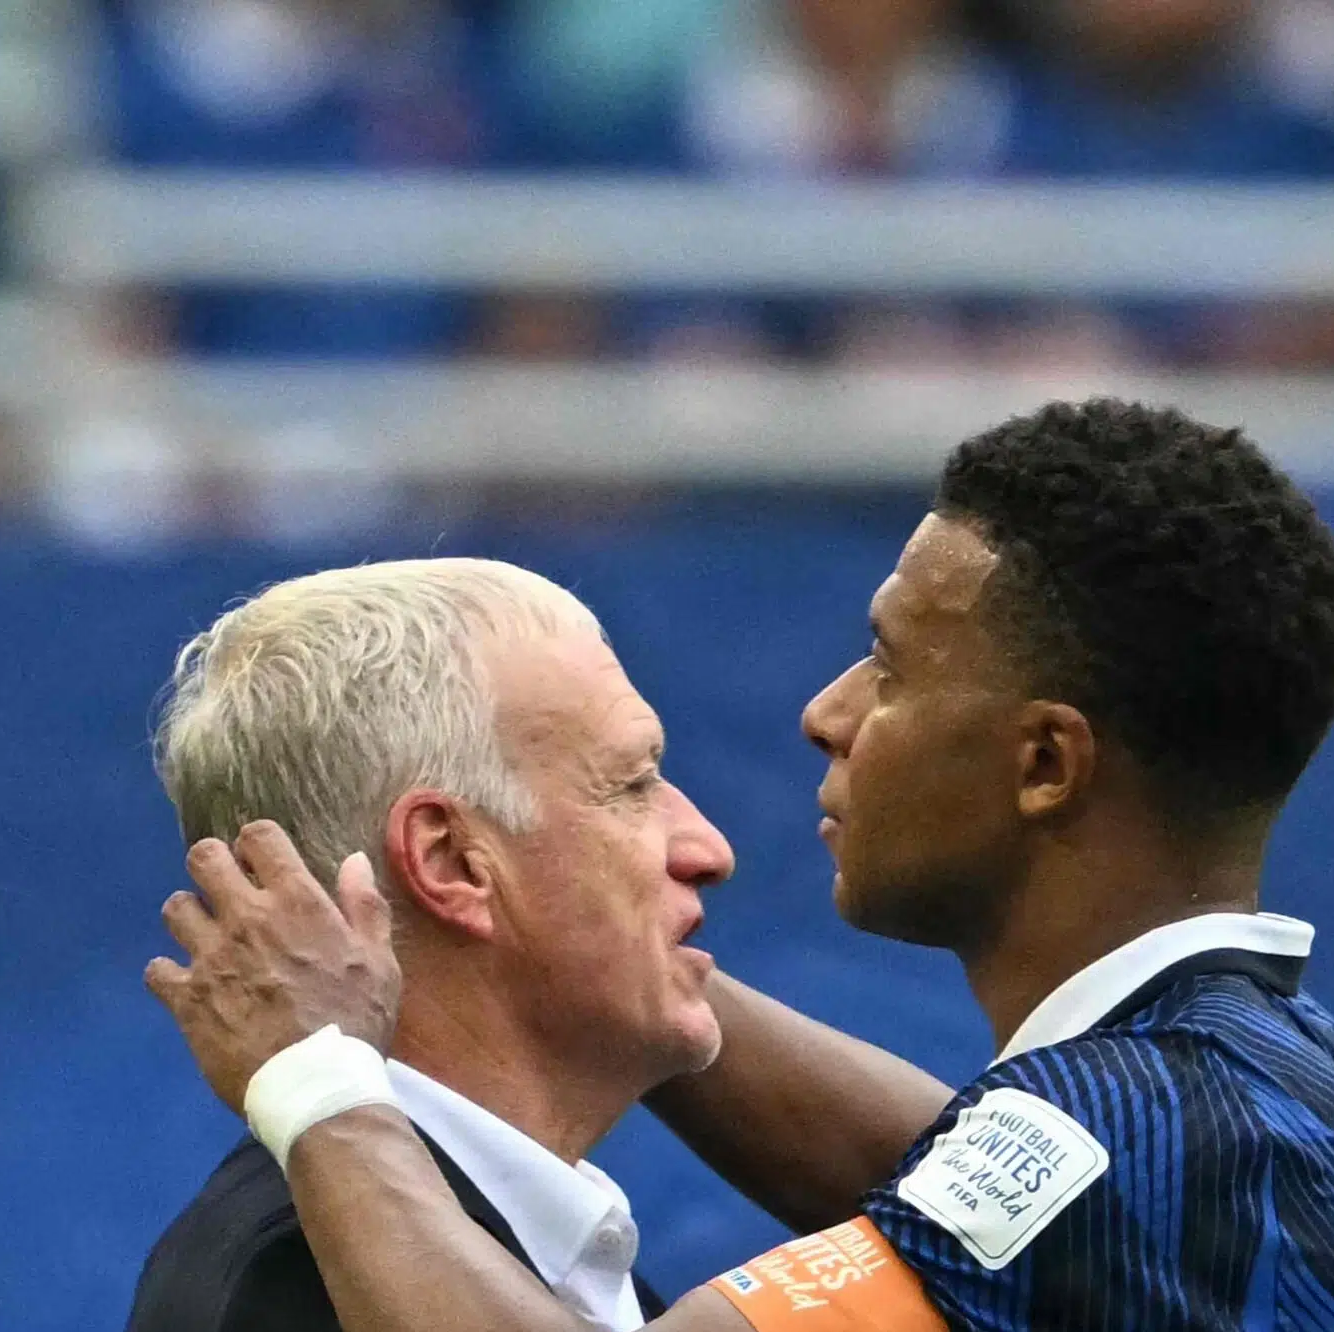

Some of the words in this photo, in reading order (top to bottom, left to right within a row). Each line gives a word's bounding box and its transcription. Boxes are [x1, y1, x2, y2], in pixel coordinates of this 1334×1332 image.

[941, 1148, 971, 1174] the
[967, 1163, 1033, 1222] World
[966, 1124, 1052, 1194] UNITES
[946, 1182, 979, 1212] FIFA
